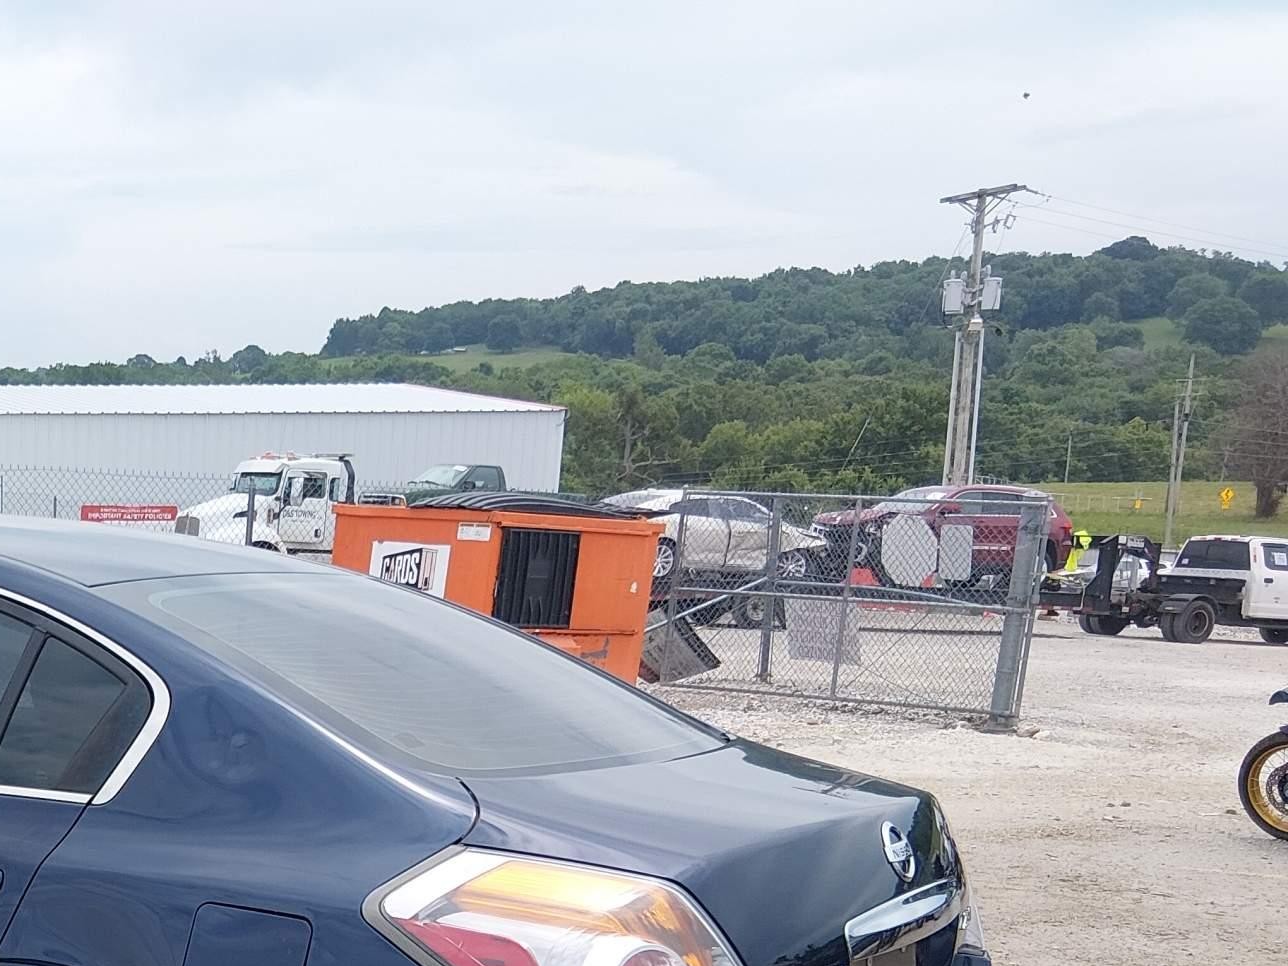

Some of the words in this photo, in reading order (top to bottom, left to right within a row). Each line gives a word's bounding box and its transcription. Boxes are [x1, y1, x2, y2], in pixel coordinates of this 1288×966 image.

[87, 512, 122, 520] IMPORTANT
[123, 512, 144, 520] SAFETY
[381, 551, 420, 586] CARDS
